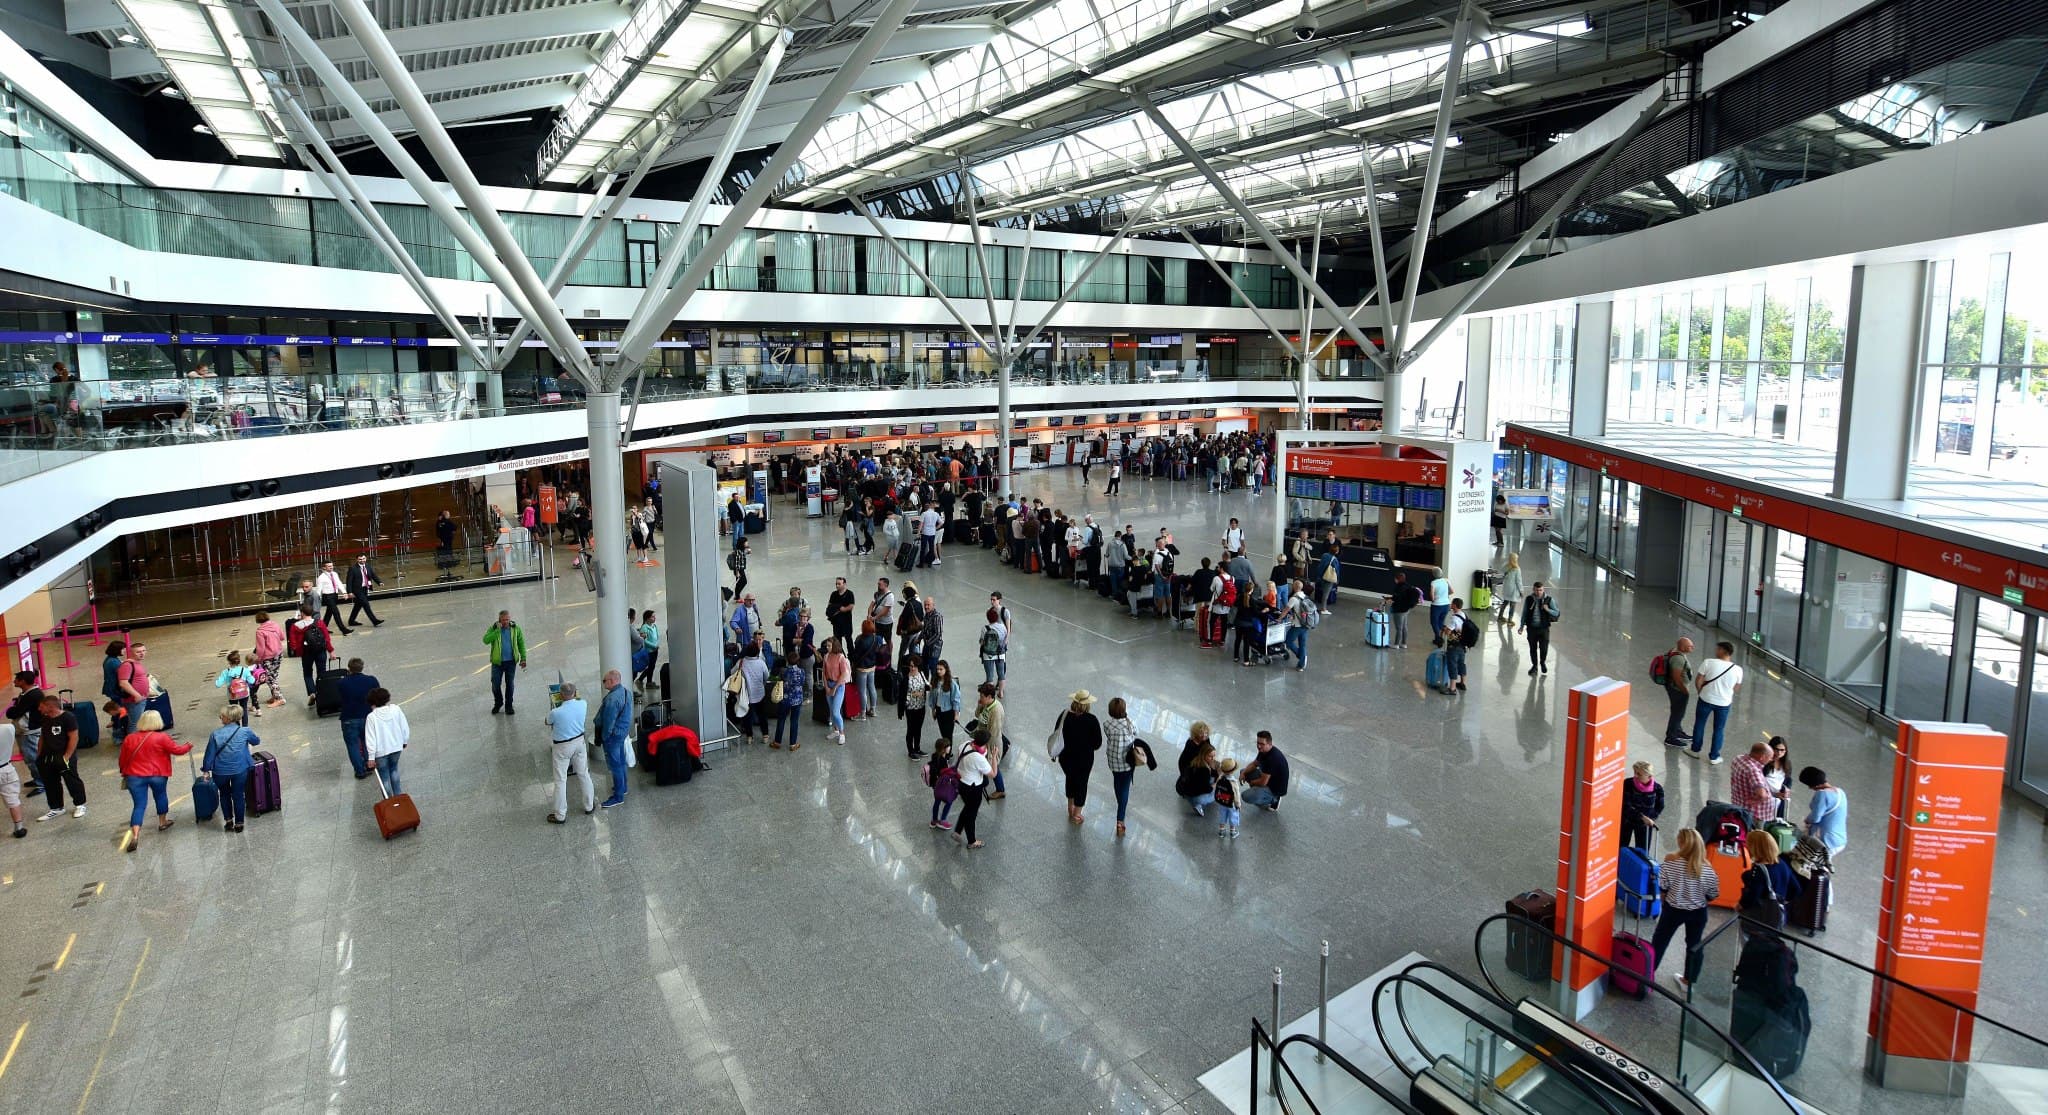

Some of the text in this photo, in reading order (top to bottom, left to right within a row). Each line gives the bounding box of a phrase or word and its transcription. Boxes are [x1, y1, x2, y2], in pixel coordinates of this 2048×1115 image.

[102, 334, 121, 342] LOT
[498, 460, 524, 471] Kontrola
[1302, 456, 1333, 466] Informacja
[1458, 490, 1484, 498] LOTNISKO
[1953, 552, 1962, 566] P
